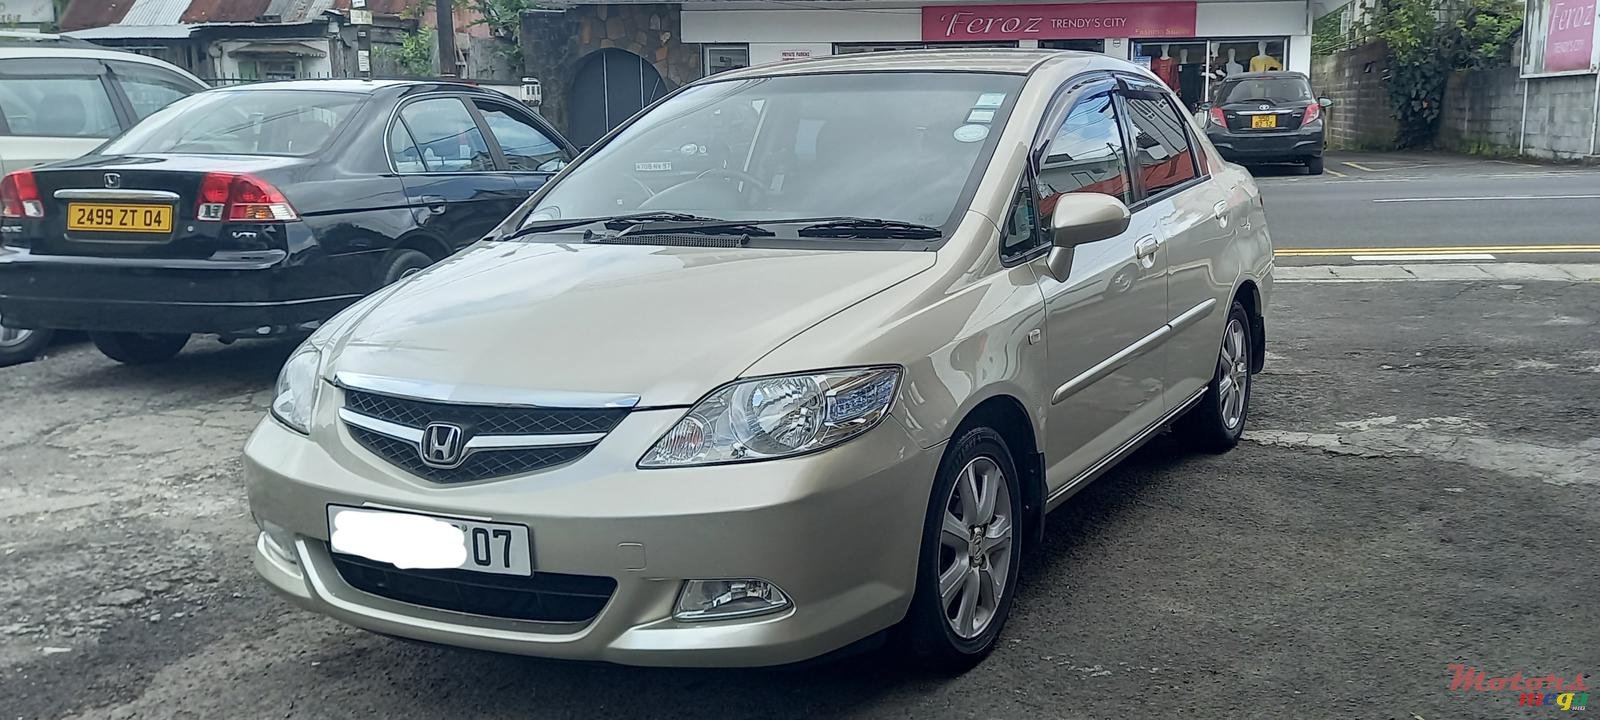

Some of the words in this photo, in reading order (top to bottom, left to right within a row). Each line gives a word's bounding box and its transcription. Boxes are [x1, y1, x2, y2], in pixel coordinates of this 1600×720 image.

[940, 12, 1042, 36] Feroz
[1050, 18, 1101, 29] TRENDY'S
[1103, 17, 1128, 28] CITY
[1549, 2, 1595, 35] Feroz
[77, 208, 113, 226] 2499
[119, 209, 138, 226] ZT
[143, 209, 163, 227] 04
[472, 527, 512, 568] 07
